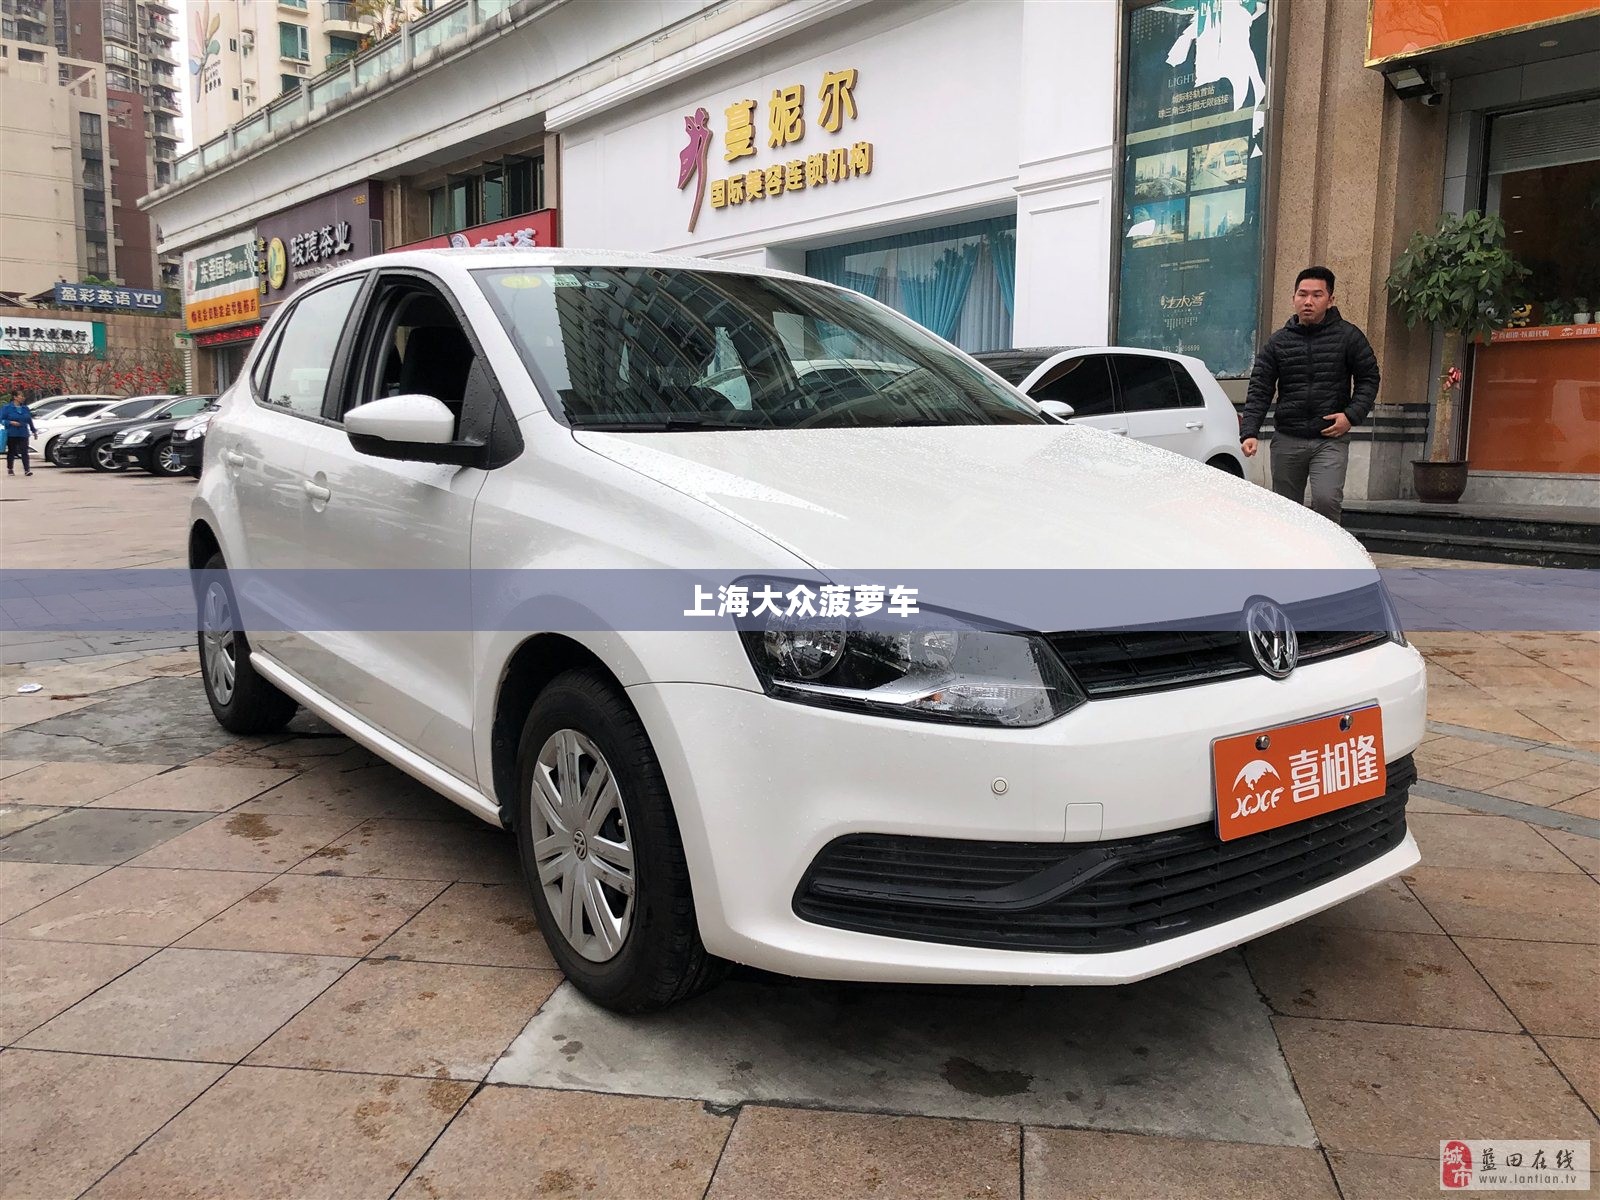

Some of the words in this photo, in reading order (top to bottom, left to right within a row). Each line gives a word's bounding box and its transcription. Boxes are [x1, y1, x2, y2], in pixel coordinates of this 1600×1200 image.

[723, 68, 859, 162] 蔓妮尔
[710, 141, 873, 210] 国际美容连锁机构
[291, 221, 351, 267] 骏德茶业
[61, 286, 131, 306] 盈彩英语
[133, 292, 162, 305] YFU
[5, 325, 88, 342] 中国农业银行
[1288, 734, 1379, 803] 喜相逢
